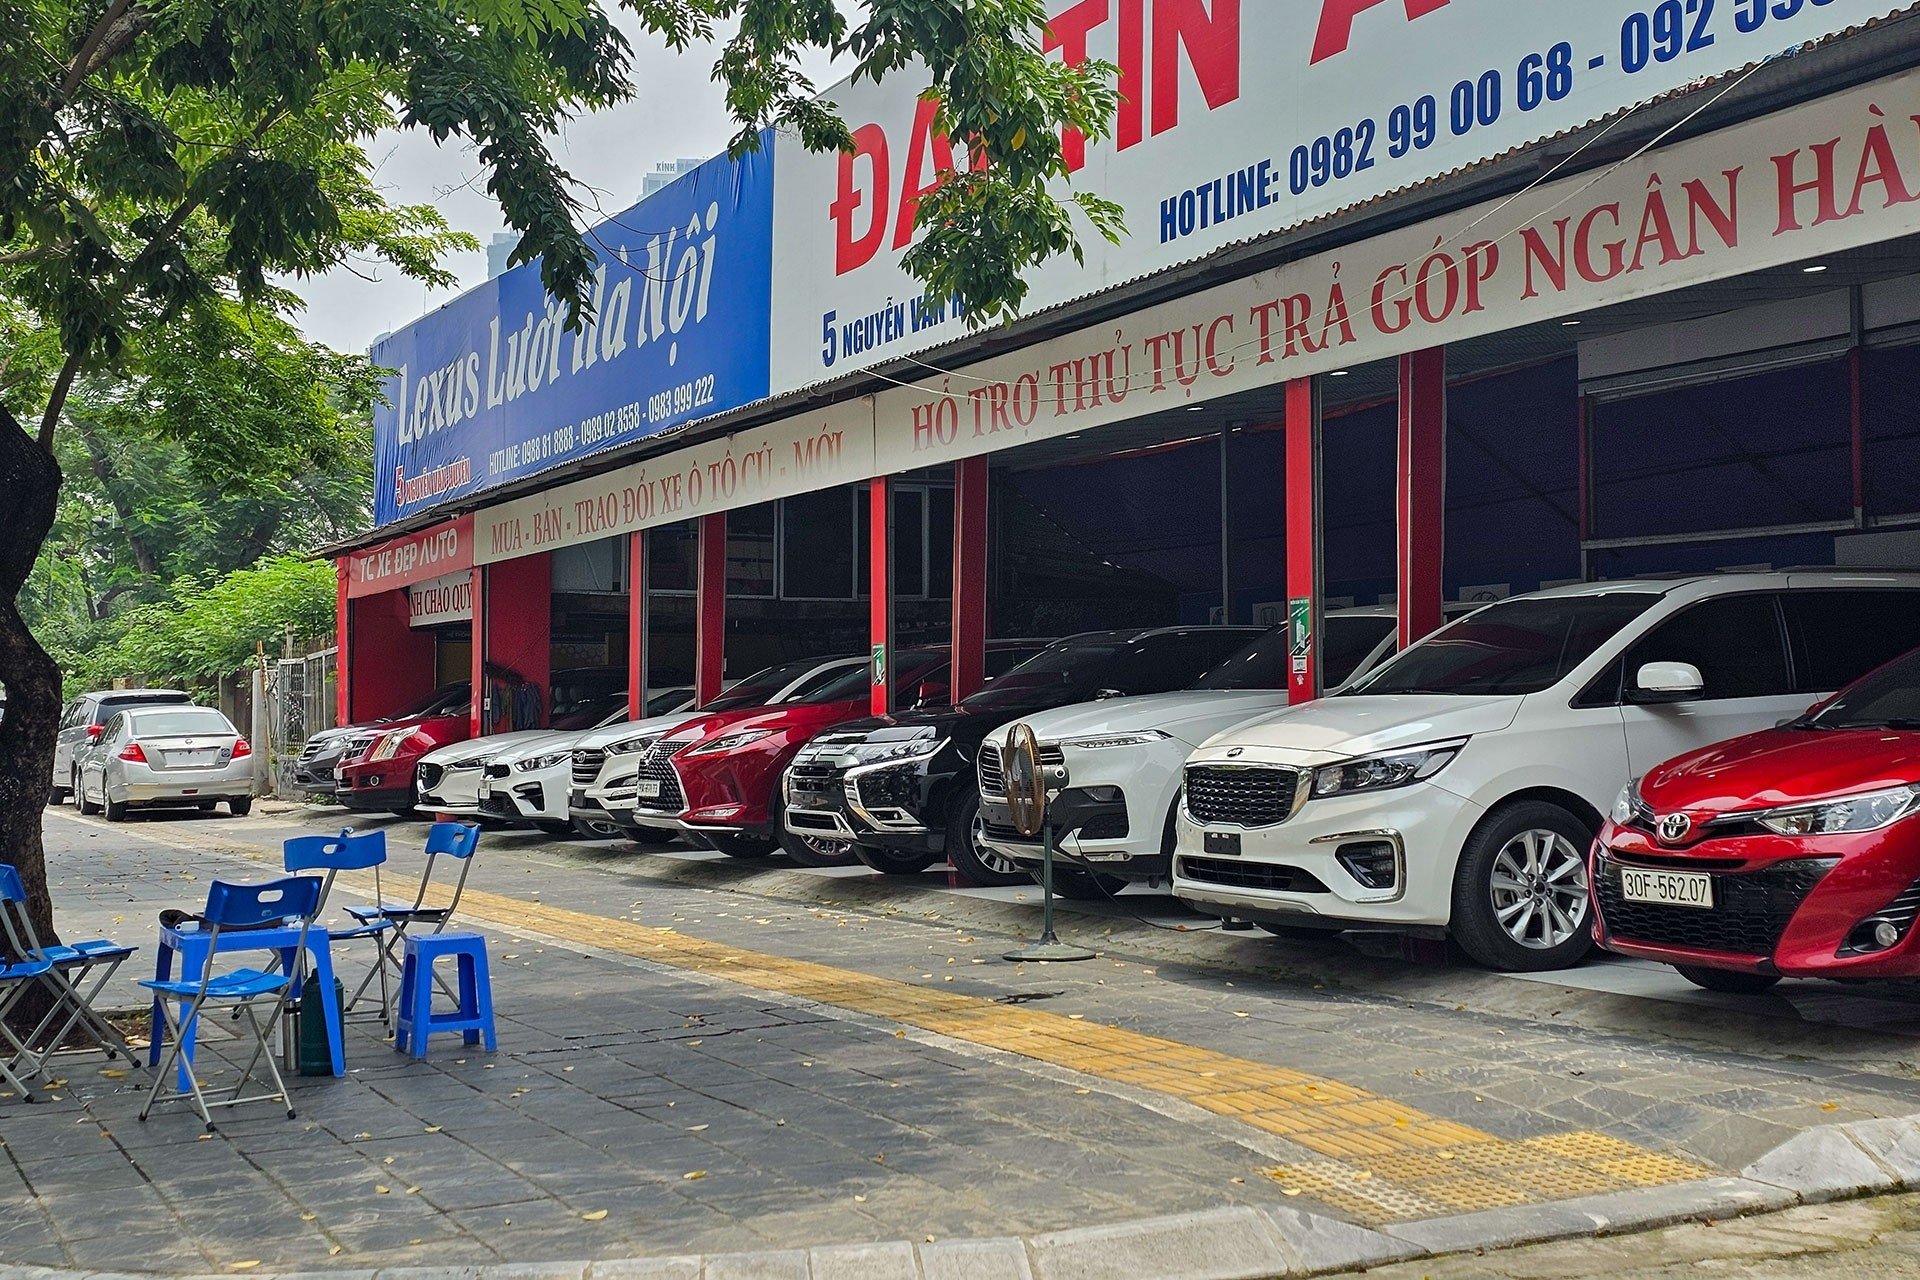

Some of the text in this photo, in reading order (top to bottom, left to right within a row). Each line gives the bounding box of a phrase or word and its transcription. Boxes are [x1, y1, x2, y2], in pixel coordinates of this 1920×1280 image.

[1159, 158, 1279, 243] HOTLINE:
[1289, 118, 1375, 195] 0982
[1388, 95, 1436, 158] 99
[1450, 70, 1502, 136] 00
[1517, 41, 1573, 111] 68
[1620, 0, 1715, 74] 092
[656, 161, 675, 172] KÍNH
[911, 103, 1920, 453] HỖ TRỢ THỦ TỤC TRẢ GÓP NGÂN HÀ
[398, 351, 480, 448] Lexus
[637, 200, 719, 367] Nội
[822, 310, 837, 368] 5
[843, 296, 905, 359] NGUYỄN
[489, 445, 520, 476] HOTLINE:
[522, 438, 541, 465] 0988
[542, 432, 551, 459] 81
[553, 425, 574, 455] 8888
[581, 415, 602, 445] 0989
[604, 410, 616, 437] 02
[617, 401, 641, 433] 8558
[648, 391, 672, 423] 0983
[674, 382, 692, 414] 999
[694, 373, 715, 408] 222
[396, 465, 405, 506] 5
[491, 518, 523, 555] MUA
[533, 503, 562, 546] BÁN
[575, 492, 618, 536] TRAO
[623, 469, 655, 528] ĐỔI
[660, 473, 682, 516] XE
[687, 460, 703, 506] Ô
[708, 449, 737, 502] TÔ
[360, 528, 458, 583] TC XE ĐẸP AUTO
[424, 579, 450, 615] CHÀO
[1624, 872, 1708, 904] 30F-562.07
